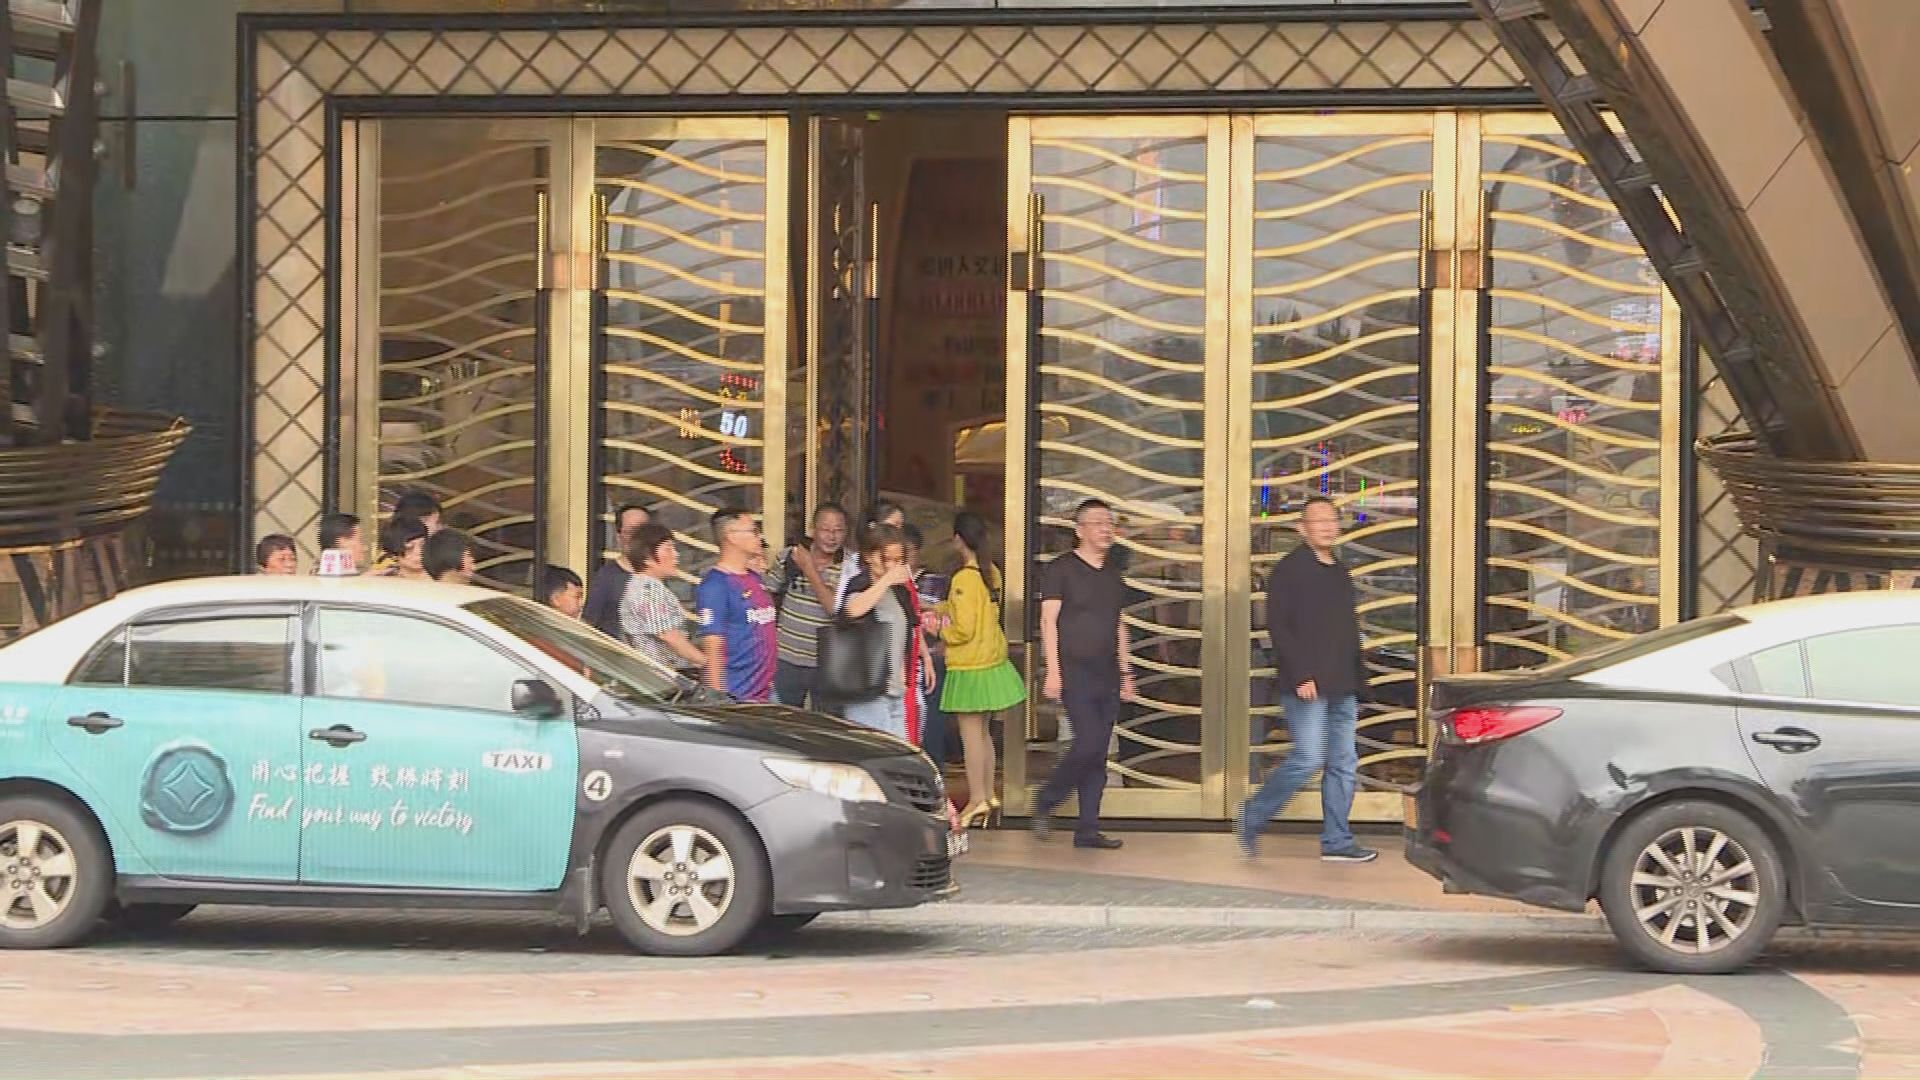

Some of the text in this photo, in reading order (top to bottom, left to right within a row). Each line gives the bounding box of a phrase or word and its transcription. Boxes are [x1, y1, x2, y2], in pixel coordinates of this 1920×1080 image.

[720, 412, 748, 438] 50
[490, 753, 543, 769] TAXI
[587, 775, 607, 798] 4
[248, 793, 474, 836] Find your way to victory
